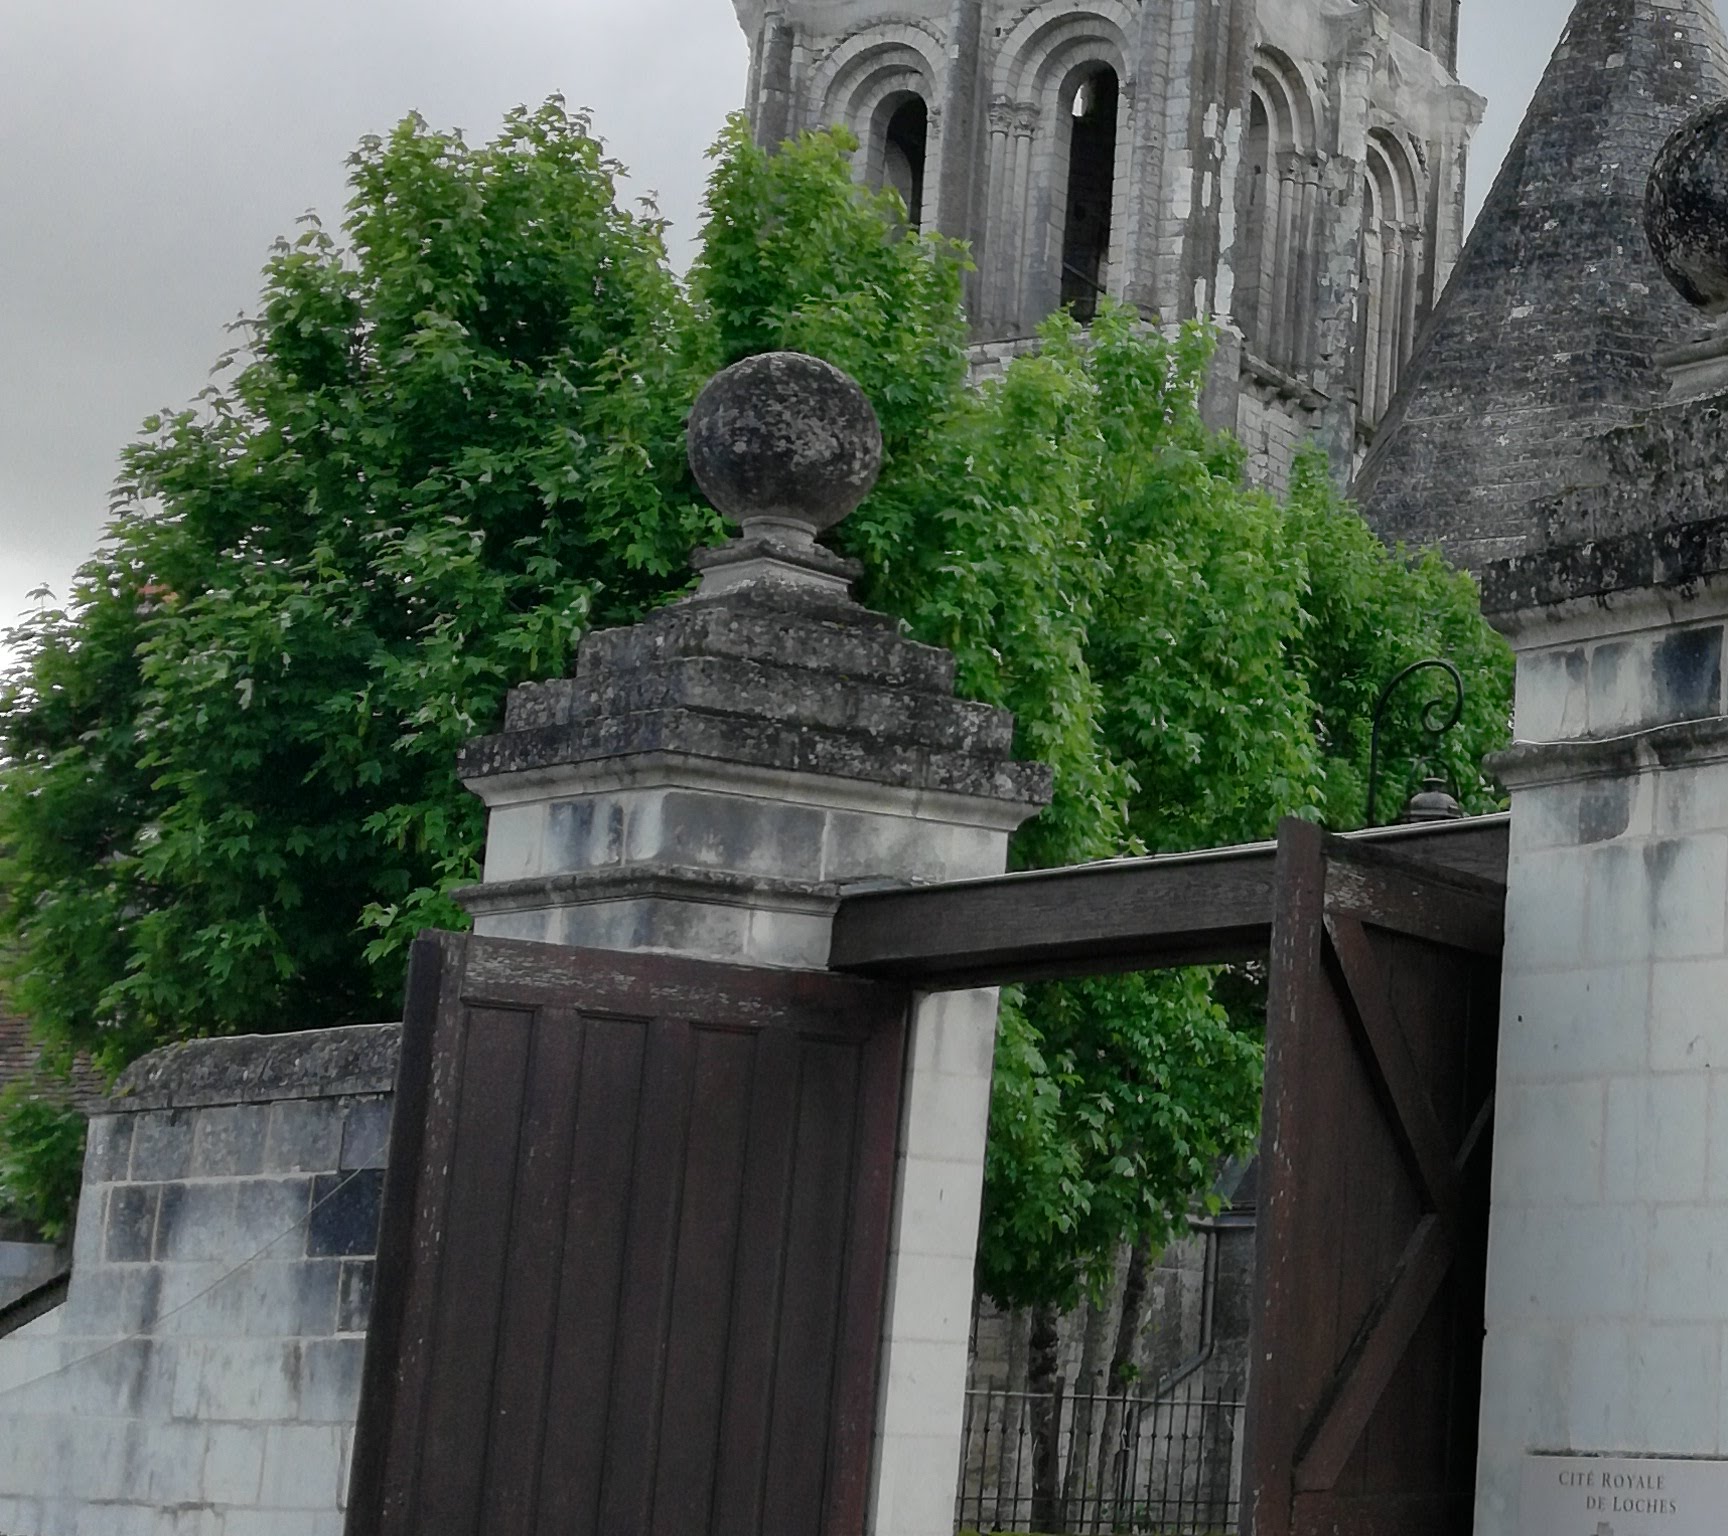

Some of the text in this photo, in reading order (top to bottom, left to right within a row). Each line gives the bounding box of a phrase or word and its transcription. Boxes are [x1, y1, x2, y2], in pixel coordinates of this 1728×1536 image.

[1558, 1470, 1664, 1490] CITÉ ROYALE
[1586, 1495, 1677, 1514] DE LOCHES
